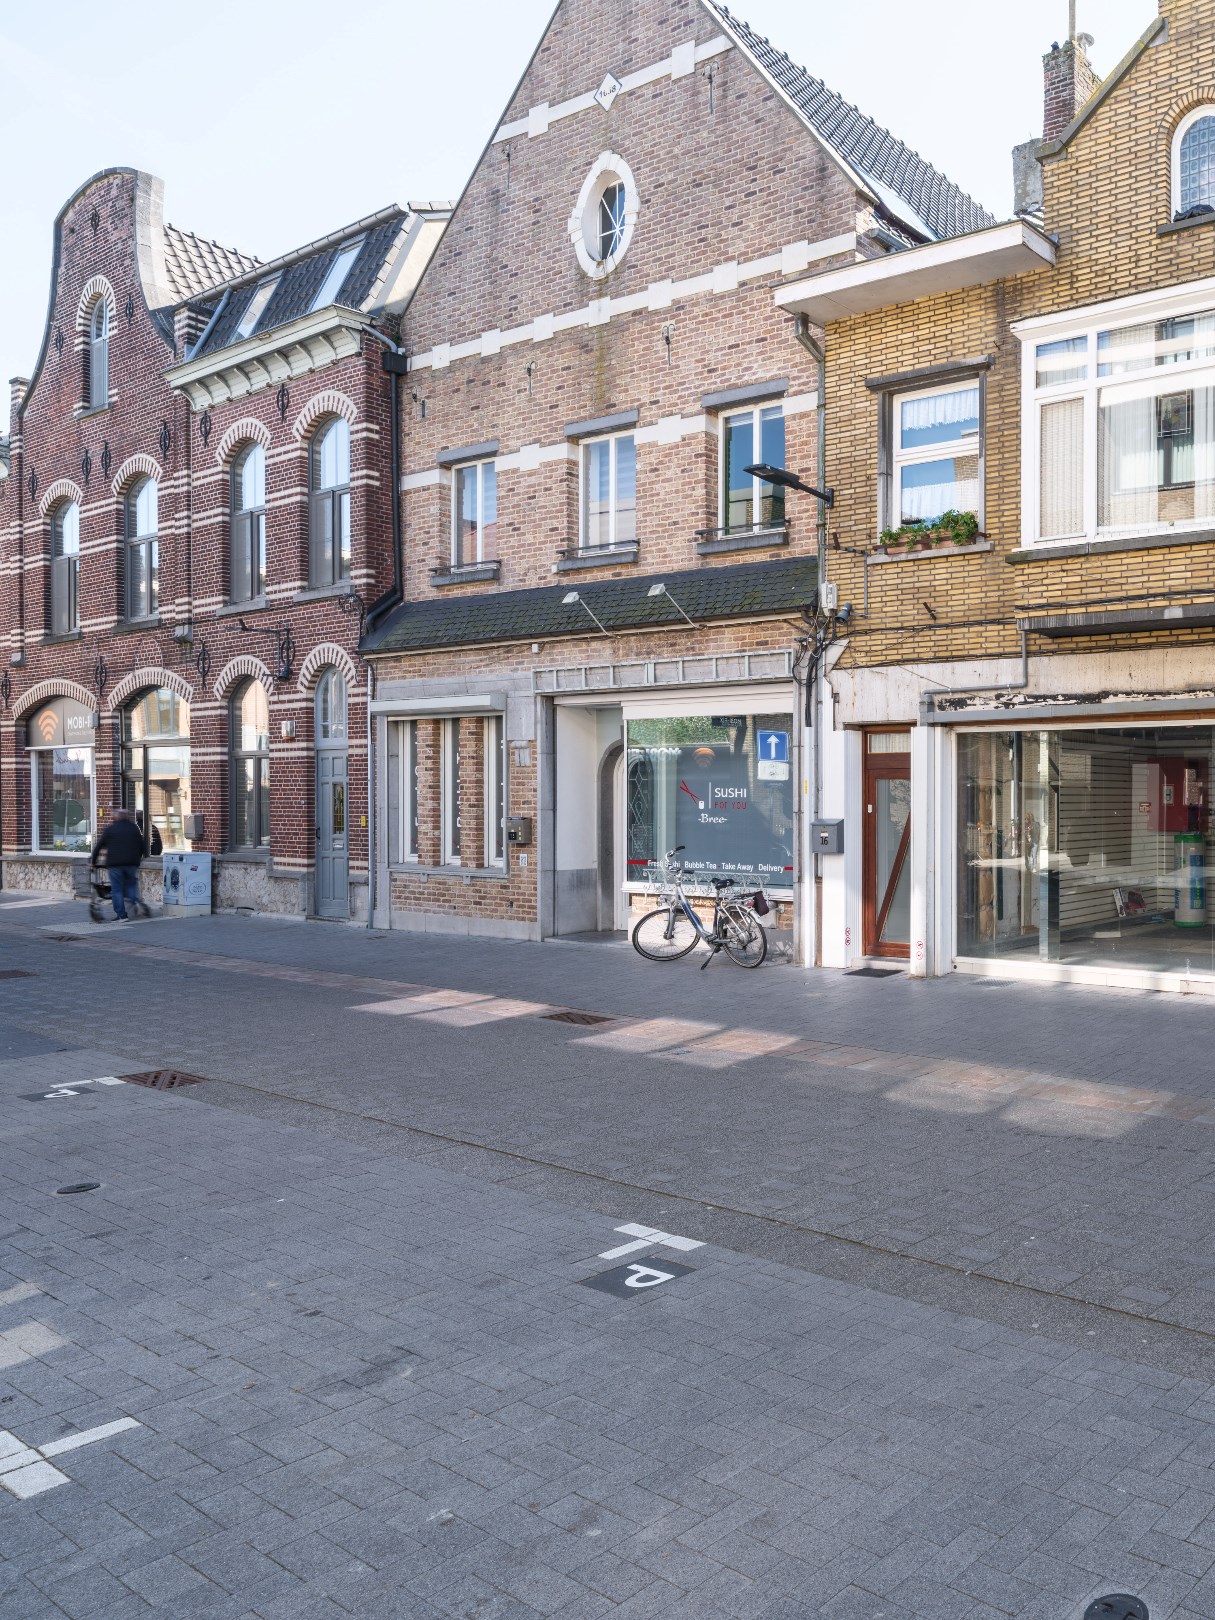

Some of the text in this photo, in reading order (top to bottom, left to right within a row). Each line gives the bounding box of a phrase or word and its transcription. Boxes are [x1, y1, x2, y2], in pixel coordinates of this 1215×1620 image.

[714, 787, 747, 798] SUSHI
[820, 836, 828, 846] 16
[664, 860, 680, 868] Shi
[684, 861, 705, 869] Bubble
[706, 861, 717, 870] Tea
[721, 862, 736, 870] Take
[736, 862, 754, 873] Away
[758, 863, 784, 874] Delivery
[624, 1263, 676, 1288] P
